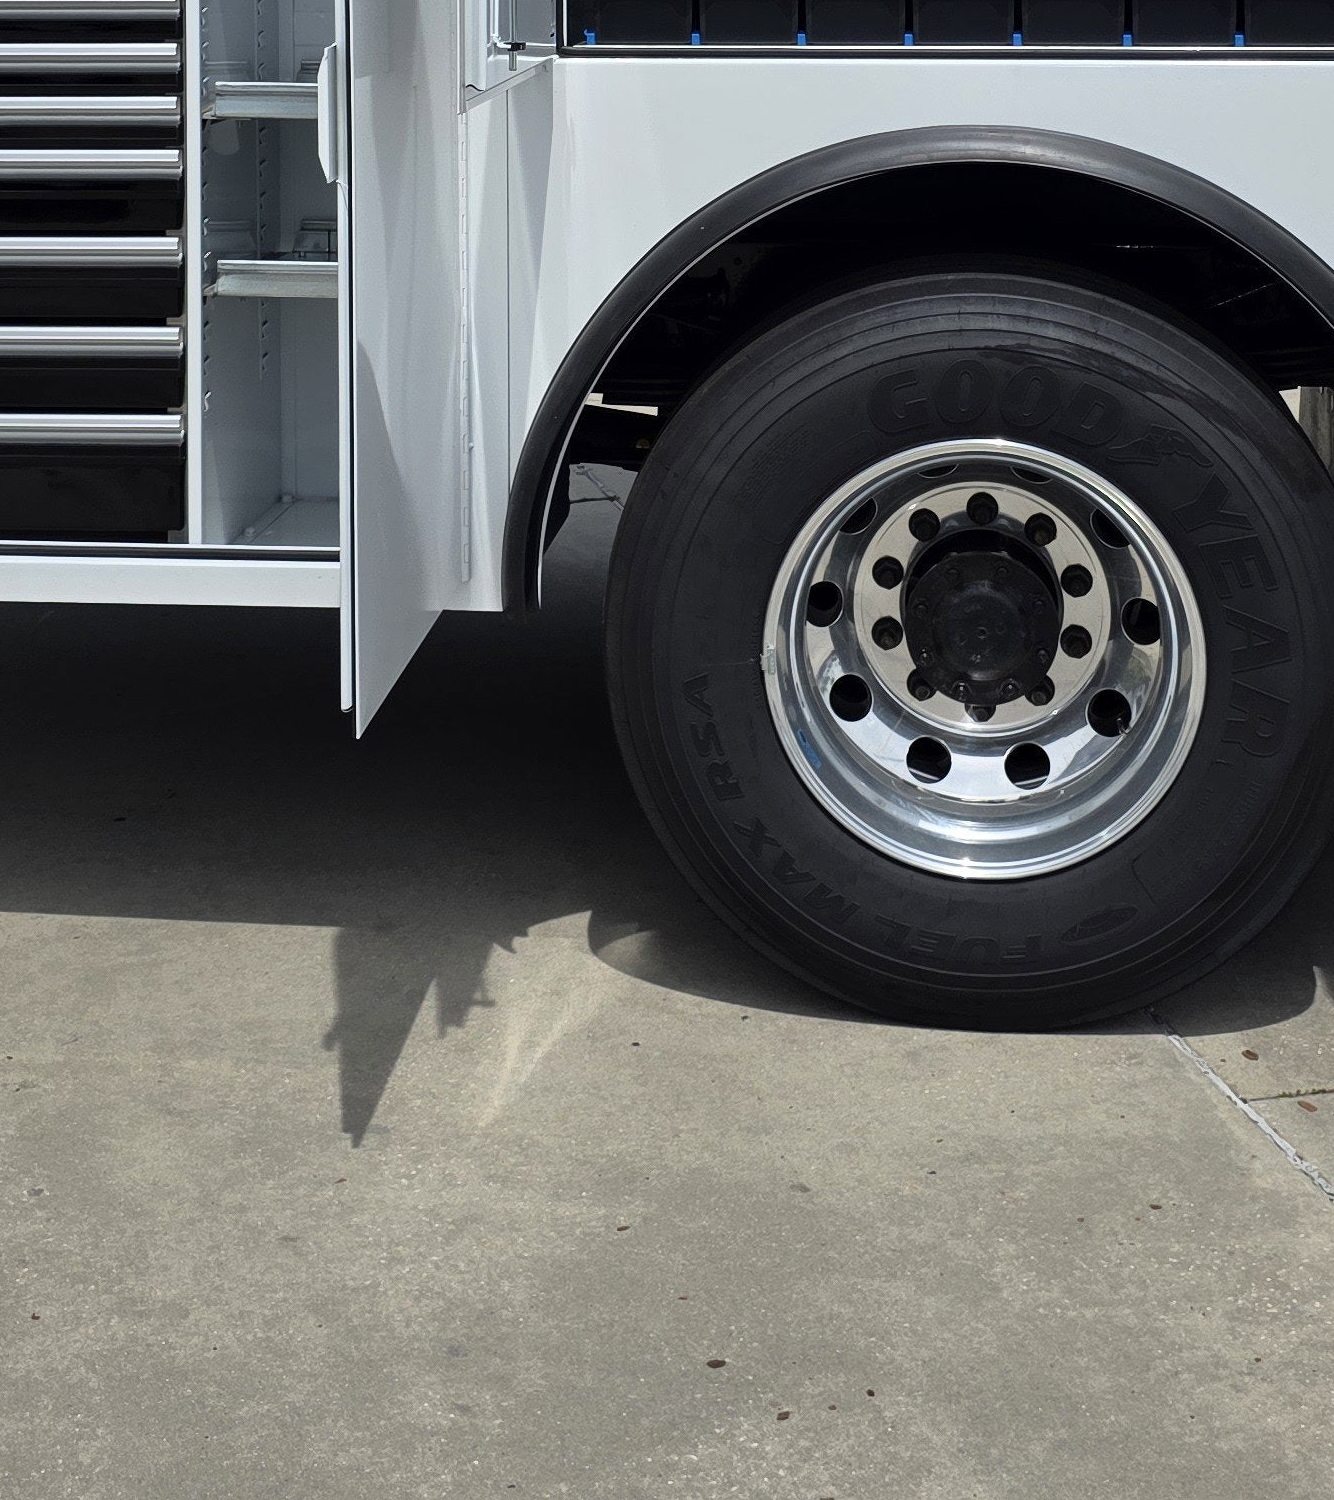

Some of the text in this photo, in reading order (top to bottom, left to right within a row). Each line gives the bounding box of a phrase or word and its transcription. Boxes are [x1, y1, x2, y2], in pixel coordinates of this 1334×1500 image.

[681, 672, 1047, 967] FUEL MAX RSA
